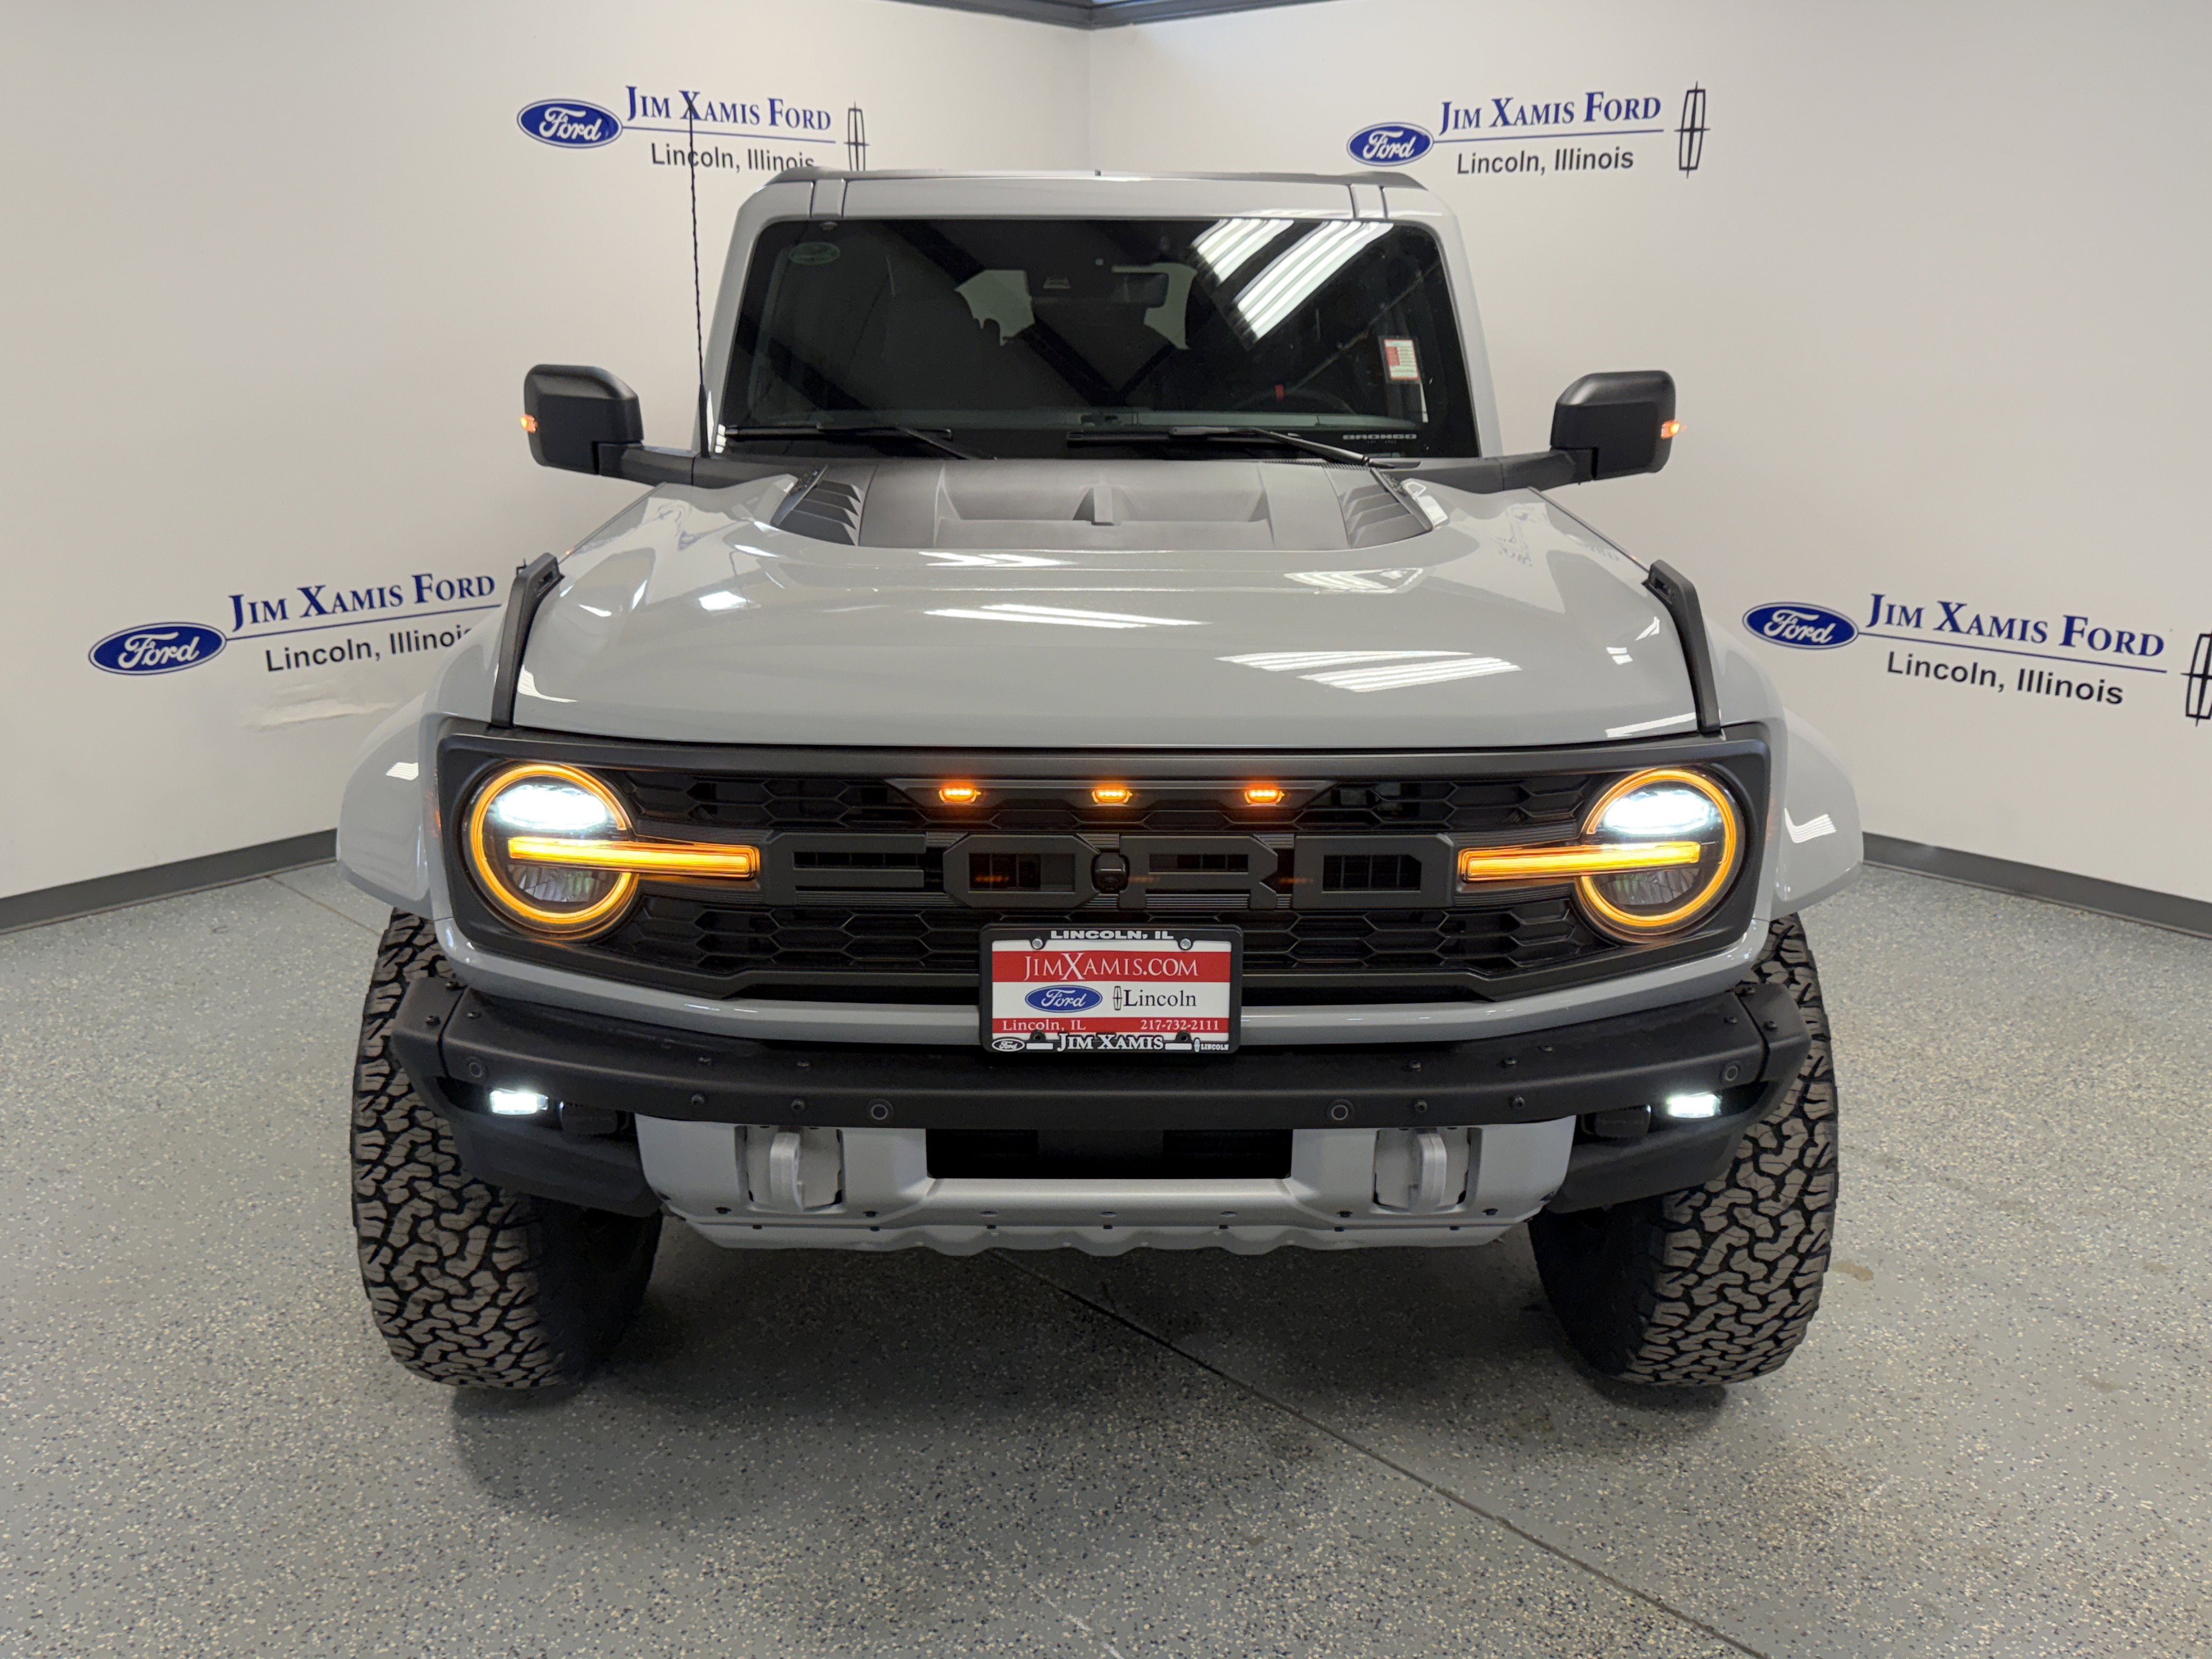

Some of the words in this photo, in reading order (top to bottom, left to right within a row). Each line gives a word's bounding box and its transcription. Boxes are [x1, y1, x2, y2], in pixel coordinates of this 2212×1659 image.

[626, 86, 671, 121] JIM
[679, 91, 760, 125] XAMIS
[768, 97, 831, 130] FORD
[1438, 101, 1481, 136] JIM
[1489, 97, 1575, 128] XAMIS
[1583, 91, 1661, 122] FORD
[539, 106, 602, 141] Ford
[651, 143, 740, 173] Lincoln,
[1362, 130, 1414, 160] Ford
[1457, 150, 1545, 175] Lincoln,
[1555, 147, 1634, 171] Illinois
[228, 594, 288, 633] JIM
[297, 585, 404, 618] XAMIS
[411, 573, 496, 604] FORD
[1763, 609, 1834, 645] Ford
[1866, 593, 1926, 629] JIM
[1933, 600, 2048, 643] XAMIS
[2058, 614, 2164, 658] FORD
[118, 631, 200, 668] Ford
[266, 639, 380, 672] Lincoln,
[1887, 651, 2005, 692] Lincoln,
[2017, 668, 2124, 705] Illinois
[761, 832, 1454, 910] FORD
[1051, 930, 1148, 940] LINCOLN,
[1155, 930, 1174, 939] IL
[1023, 952, 1199, 981] JIMXAMIS.COM
[1041, 989, 1086, 1007] Ford
[1124, 990, 1197, 1007] Lincoln
[1003, 1019, 1065, 1032] Lincoln,
[1071, 1020, 1086, 1030] IL
[1141, 1020, 1219, 1031] 217-732-2111
[998, 1040, 1018, 1049] Ford
[1057, 1033, 1093, 1052] JIM
[1097, 1034, 1164, 1050] XAMIS
